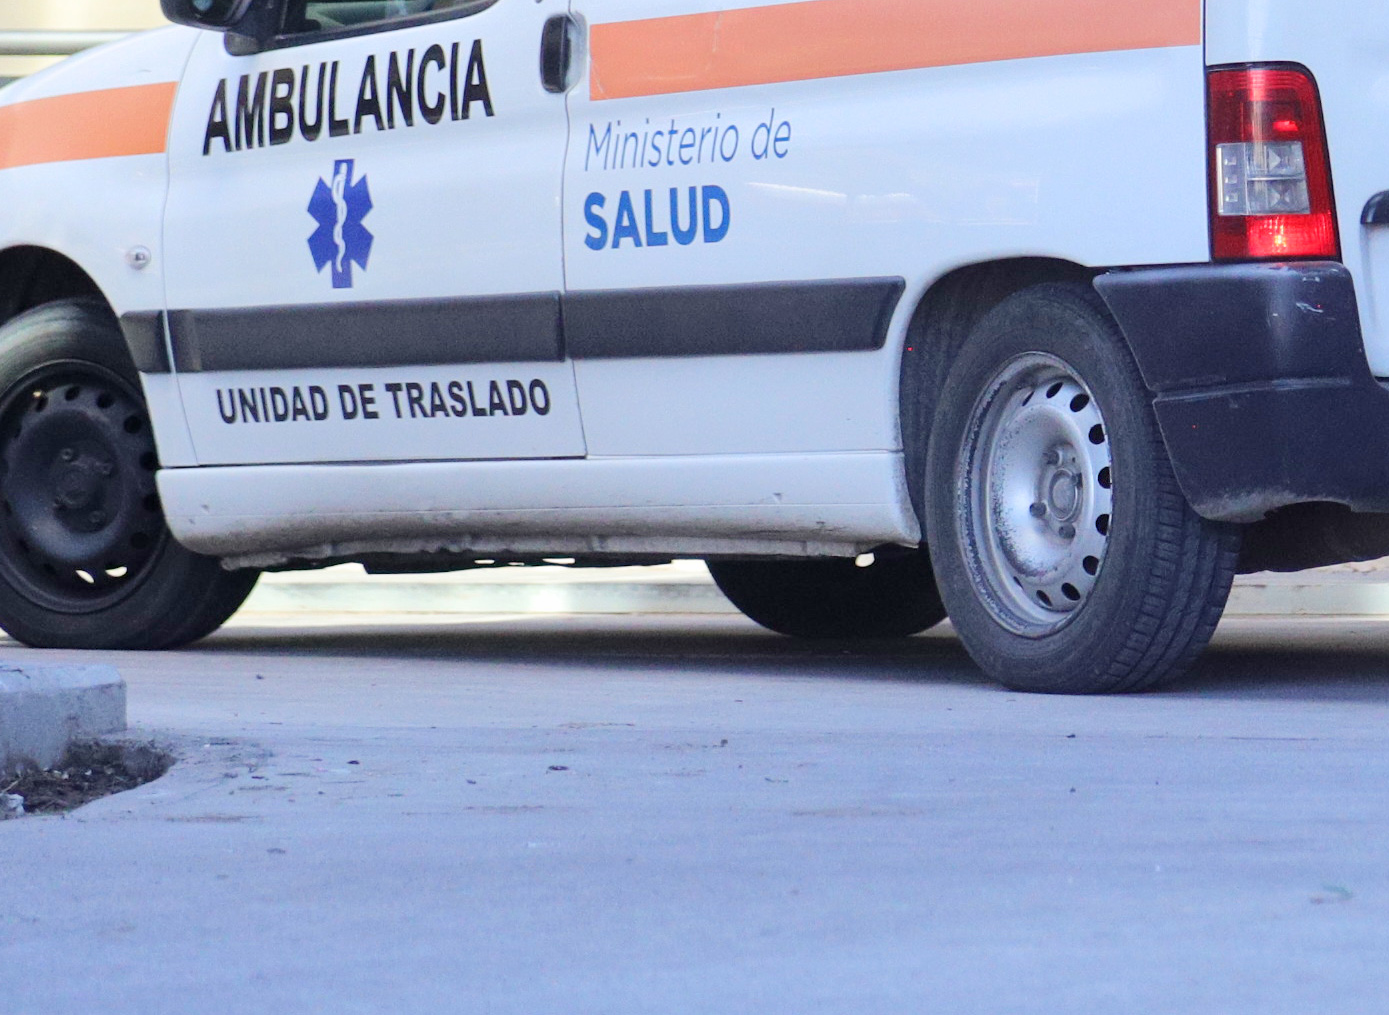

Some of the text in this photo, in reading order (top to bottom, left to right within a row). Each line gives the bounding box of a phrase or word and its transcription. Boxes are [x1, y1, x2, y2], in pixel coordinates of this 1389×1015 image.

[202, 38, 495, 156] AMBULANCIA
[585, 107, 791, 172] Ministerio de
[584, 185, 731, 251] SALUD
[216, 378, 551, 424] UNIDAD DE TRASLADO
